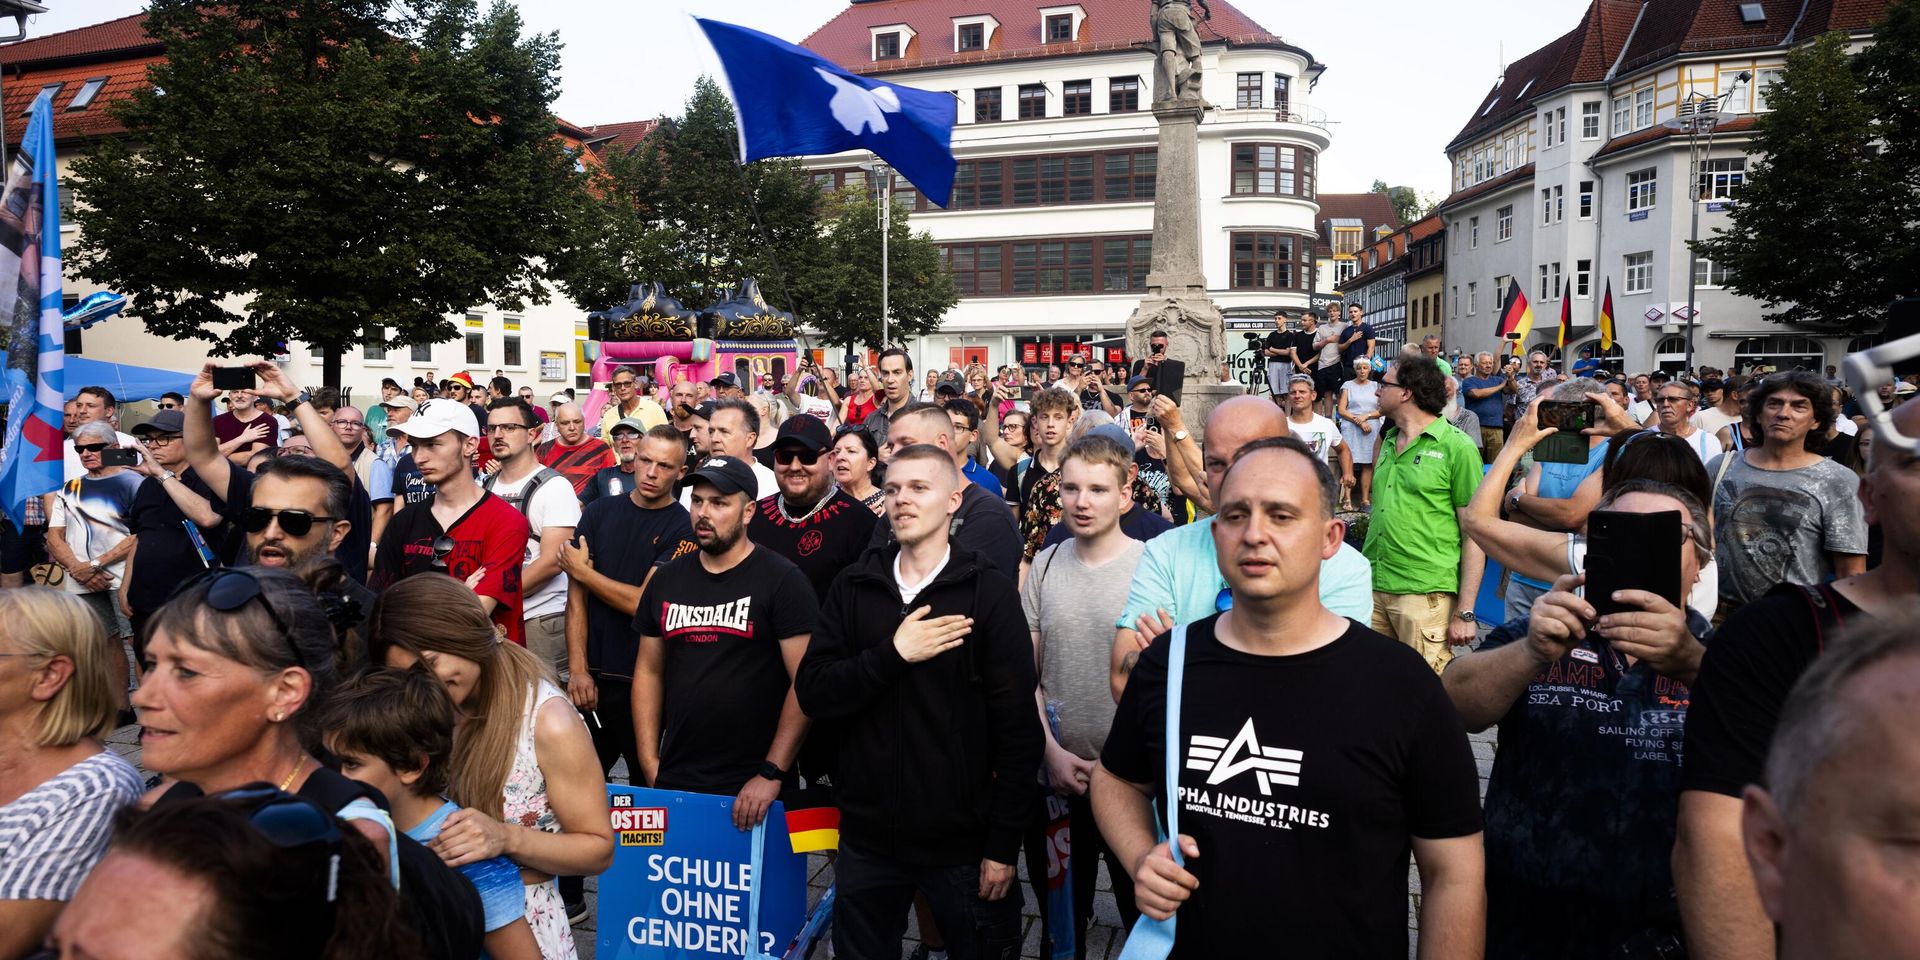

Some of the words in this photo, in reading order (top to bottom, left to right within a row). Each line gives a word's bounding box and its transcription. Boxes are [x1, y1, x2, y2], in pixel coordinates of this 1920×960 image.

[661, 596, 753, 639] LONSDALE
[686, 634, 718, 642] LONDON
[1528, 693, 1562, 705] SEA
[1571, 695, 1623, 713] PORT
[1598, 726, 1646, 736] SAILING
[1650, 729, 1674, 737] OFF
[1625, 738, 1665, 749] FLYING
[1634, 751, 1672, 762] LABEL
[613, 796, 631, 807] DER
[1178, 787, 1210, 806] PHA
[1216, 792, 1330, 829] INDUSTRIES
[610, 809, 665, 830] OSTEN
[1185, 803, 1223, 818] KNOXVILLE,
[1225, 811, 1267, 827] TENNESSEE,
[622, 832, 662, 844] MACHTS!
[647, 854, 752, 892] SCHULE
[661, 887, 741, 923] OHNE
